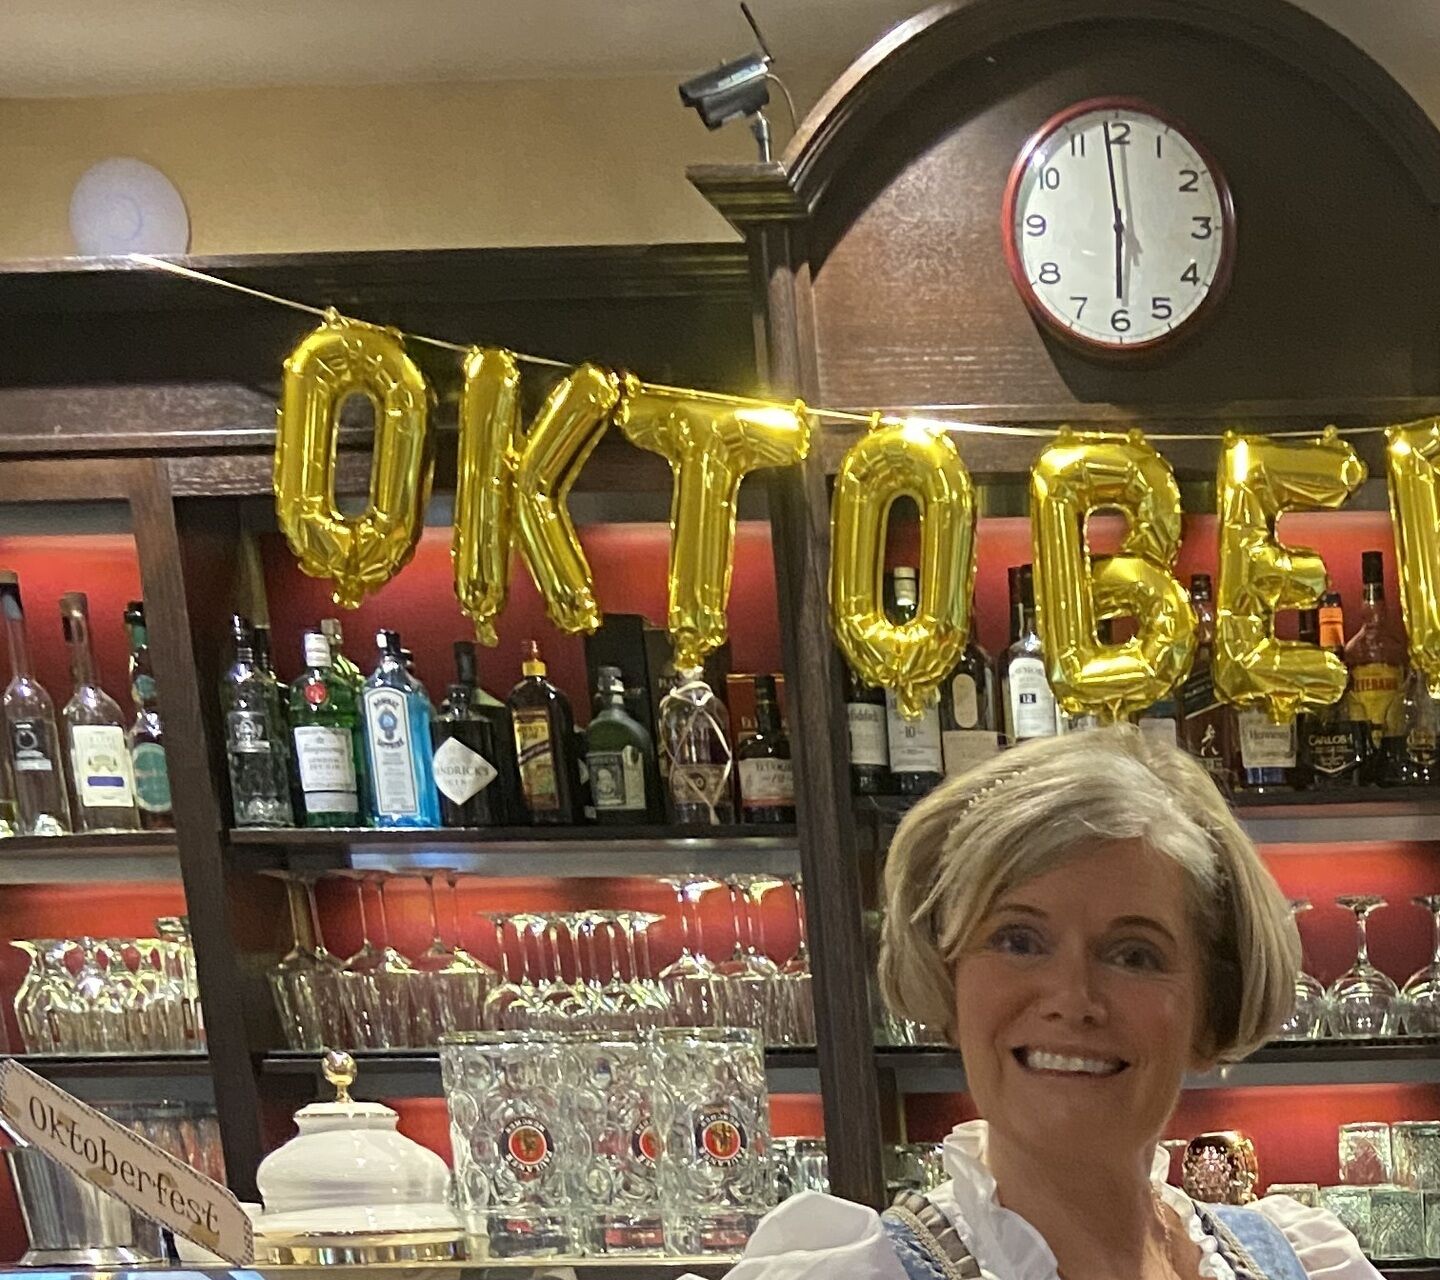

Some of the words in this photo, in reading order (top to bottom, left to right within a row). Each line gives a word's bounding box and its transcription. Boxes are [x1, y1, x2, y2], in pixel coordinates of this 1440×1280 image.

[1070, 133, 1086, 157] 11
[1103, 121, 1131, 145] 2
[1155, 135, 1162, 159] 1
[1038, 166, 1061, 191] 10
[1178, 169, 1200, 193] 2
[1025, 213, 1047, 237] 9
[1190, 215, 1213, 240] 3
[1037, 262, 1062, 285] 8
[1179, 262, 1201, 287] 4
[1069, 295, 1089, 320] 7
[1150, 296, 1173, 320] 5
[1109, 309, 1132, 333] 6
[29, 1095, 220, 1235] Oktoberfest
